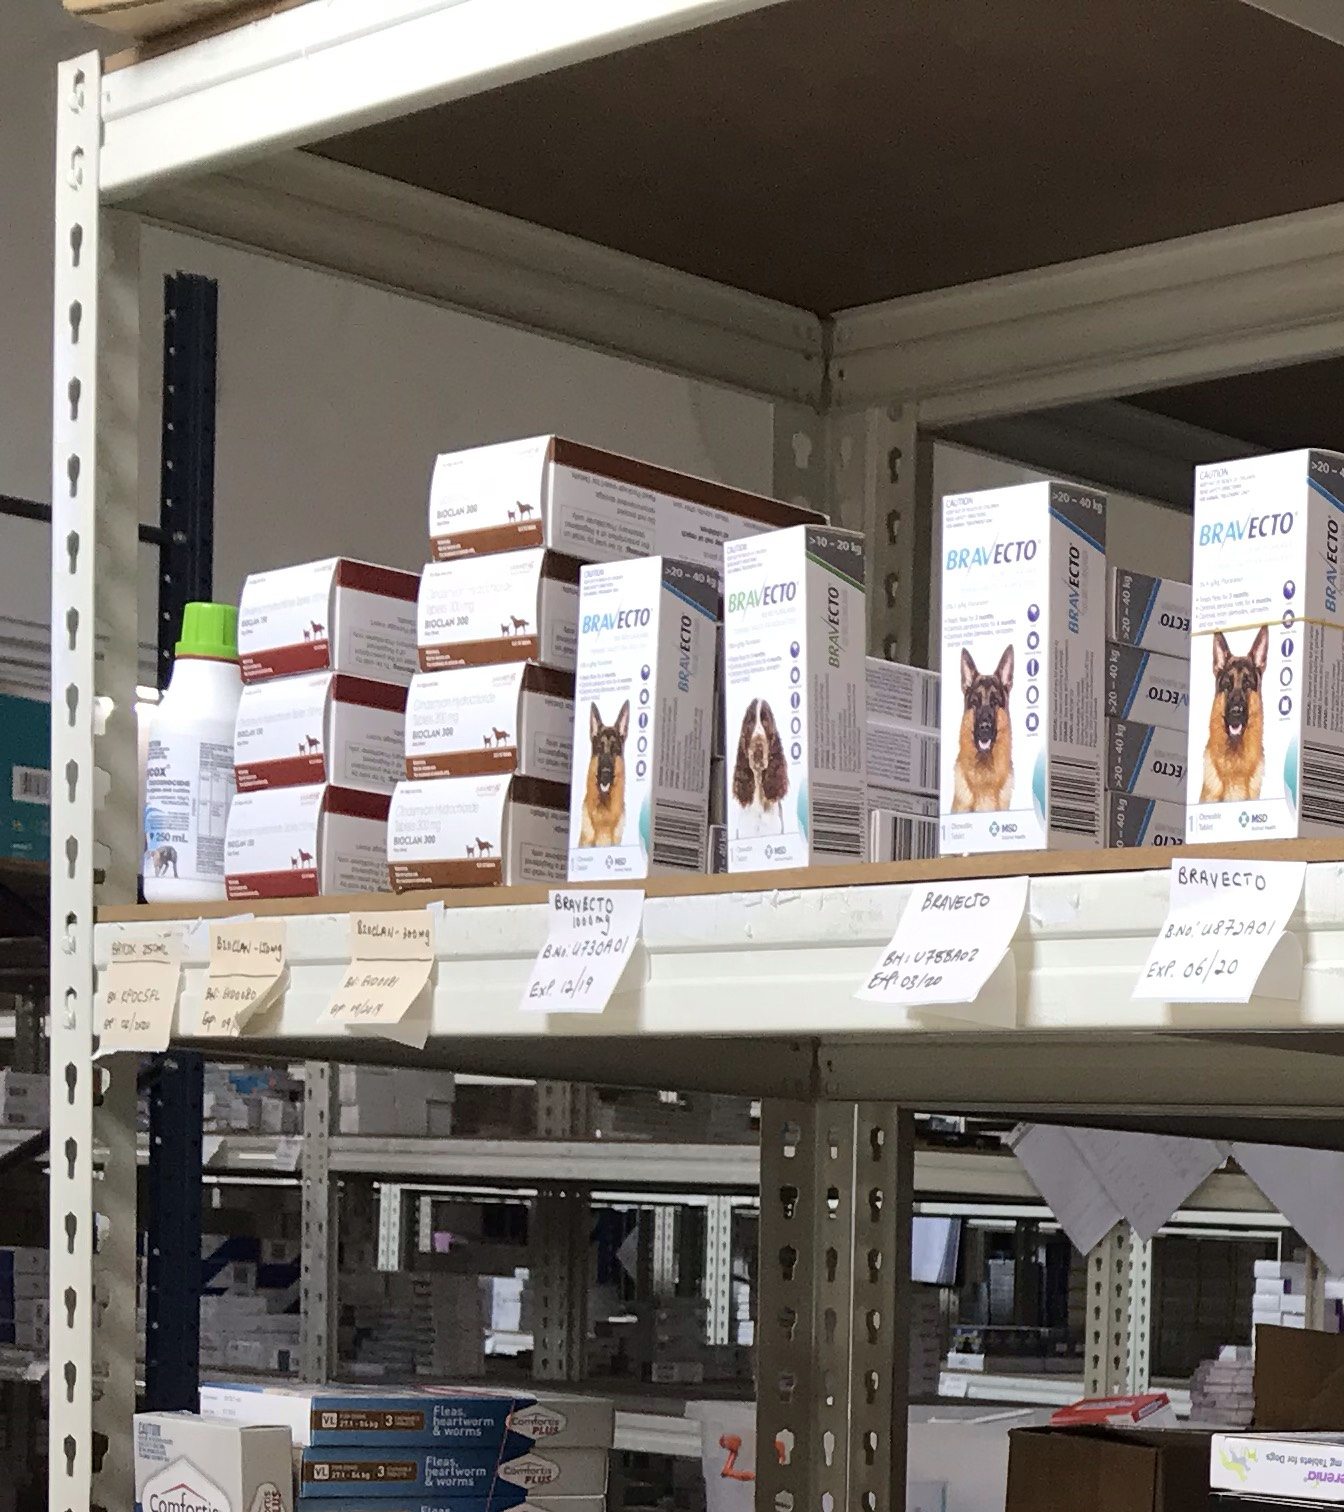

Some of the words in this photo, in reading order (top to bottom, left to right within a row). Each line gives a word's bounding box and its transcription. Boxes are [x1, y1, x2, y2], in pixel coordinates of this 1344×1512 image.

[1199, 511, 1294, 547] BRAVECTO
[946, 538, 1037, 571] BRAVECTO
[1325, 518, 1339, 612] BRAVECTO
[728, 579, 798, 614] BRAVECTO
[582, 605, 651, 636] BRAVECTO
[1178, 867, 1267, 891] BRAVECTO
[554, 893, 614, 914] BRAVECTO
[921, 891, 990, 912] BRAVECTO
[1183, 949, 1239, 985] 06/20
